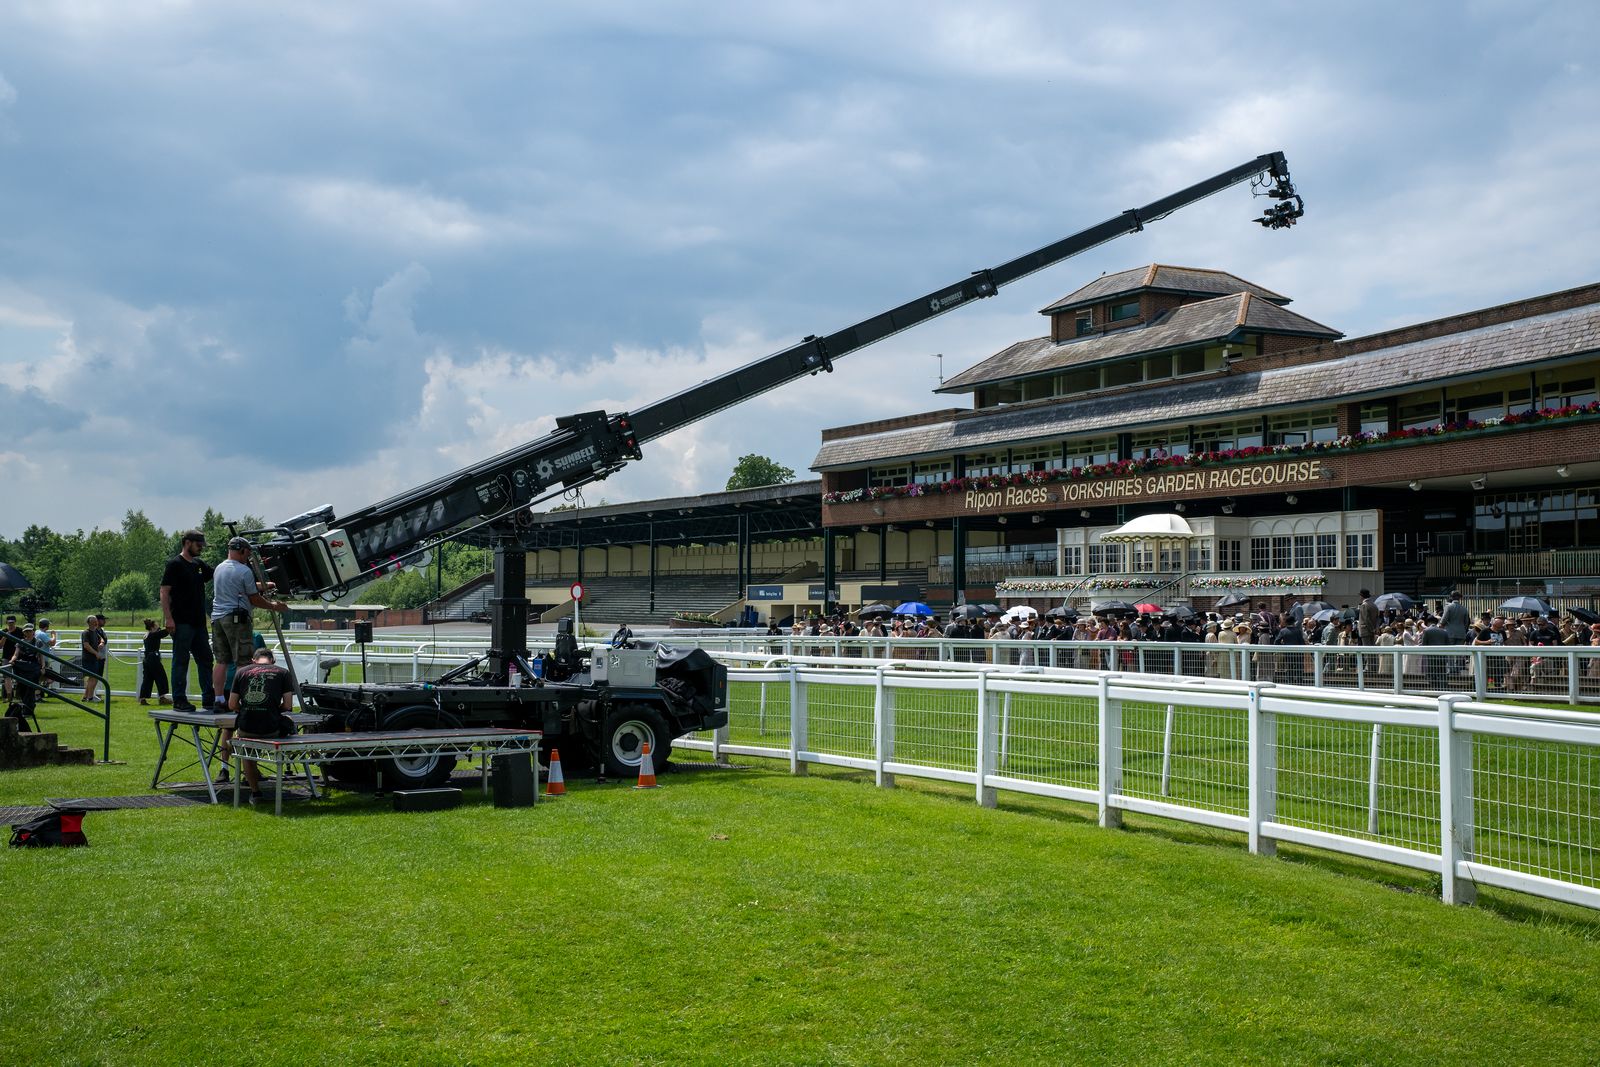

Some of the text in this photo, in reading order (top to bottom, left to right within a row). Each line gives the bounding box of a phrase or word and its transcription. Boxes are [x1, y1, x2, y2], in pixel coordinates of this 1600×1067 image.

[554, 445, 596, 469] SUNBELT
[562, 456, 592, 471] RENTALS
[965, 460, 1321, 512] Ripon Races YORKSHIRE'S GARDEN RACECOURSE
